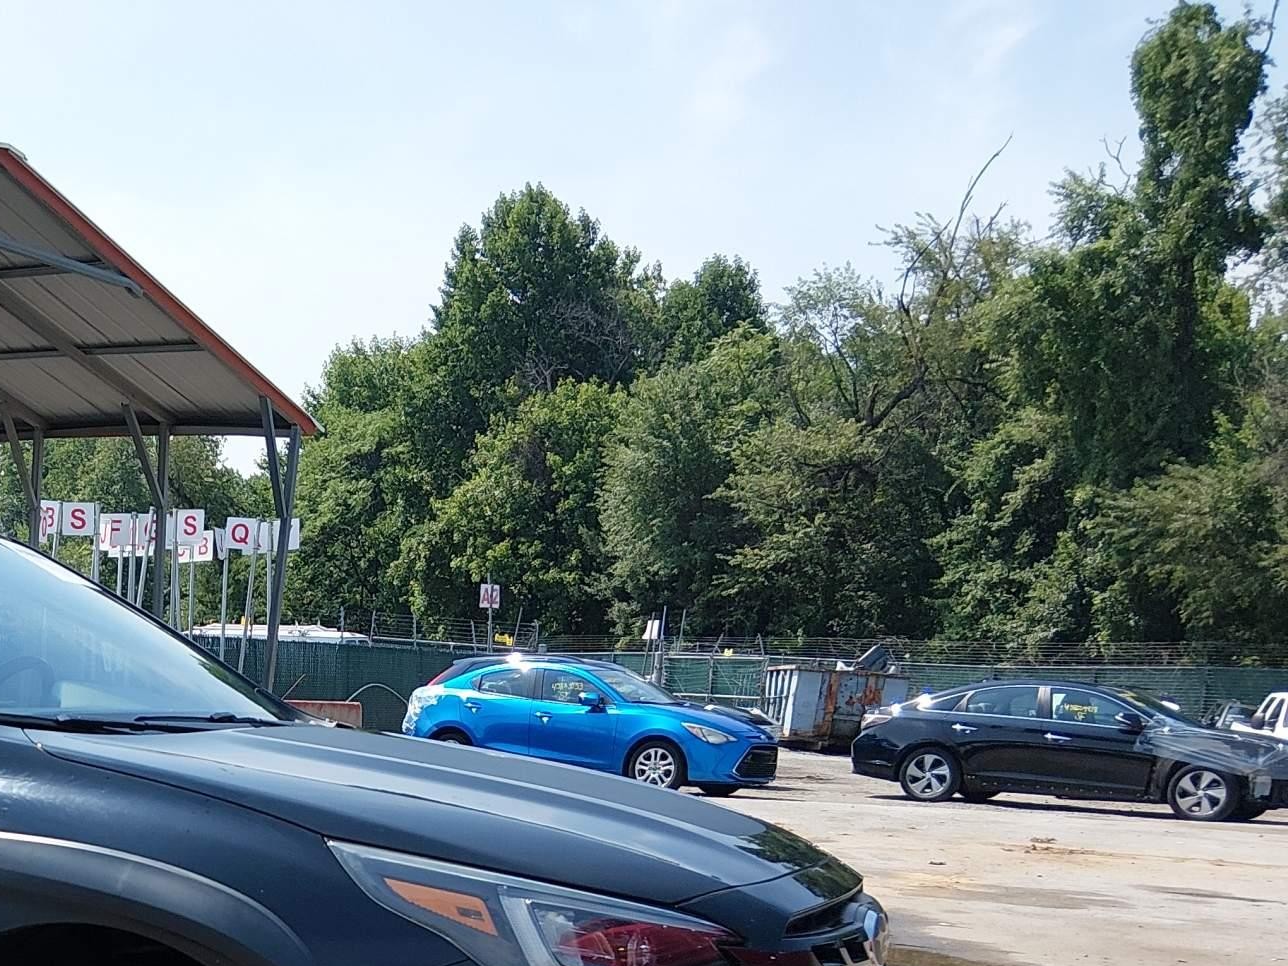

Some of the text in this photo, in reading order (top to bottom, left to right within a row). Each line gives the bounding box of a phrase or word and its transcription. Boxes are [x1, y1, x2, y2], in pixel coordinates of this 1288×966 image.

[71, 508, 86, 530] S
[183, 515, 197, 536] S
[231, 523, 249, 545] Q
